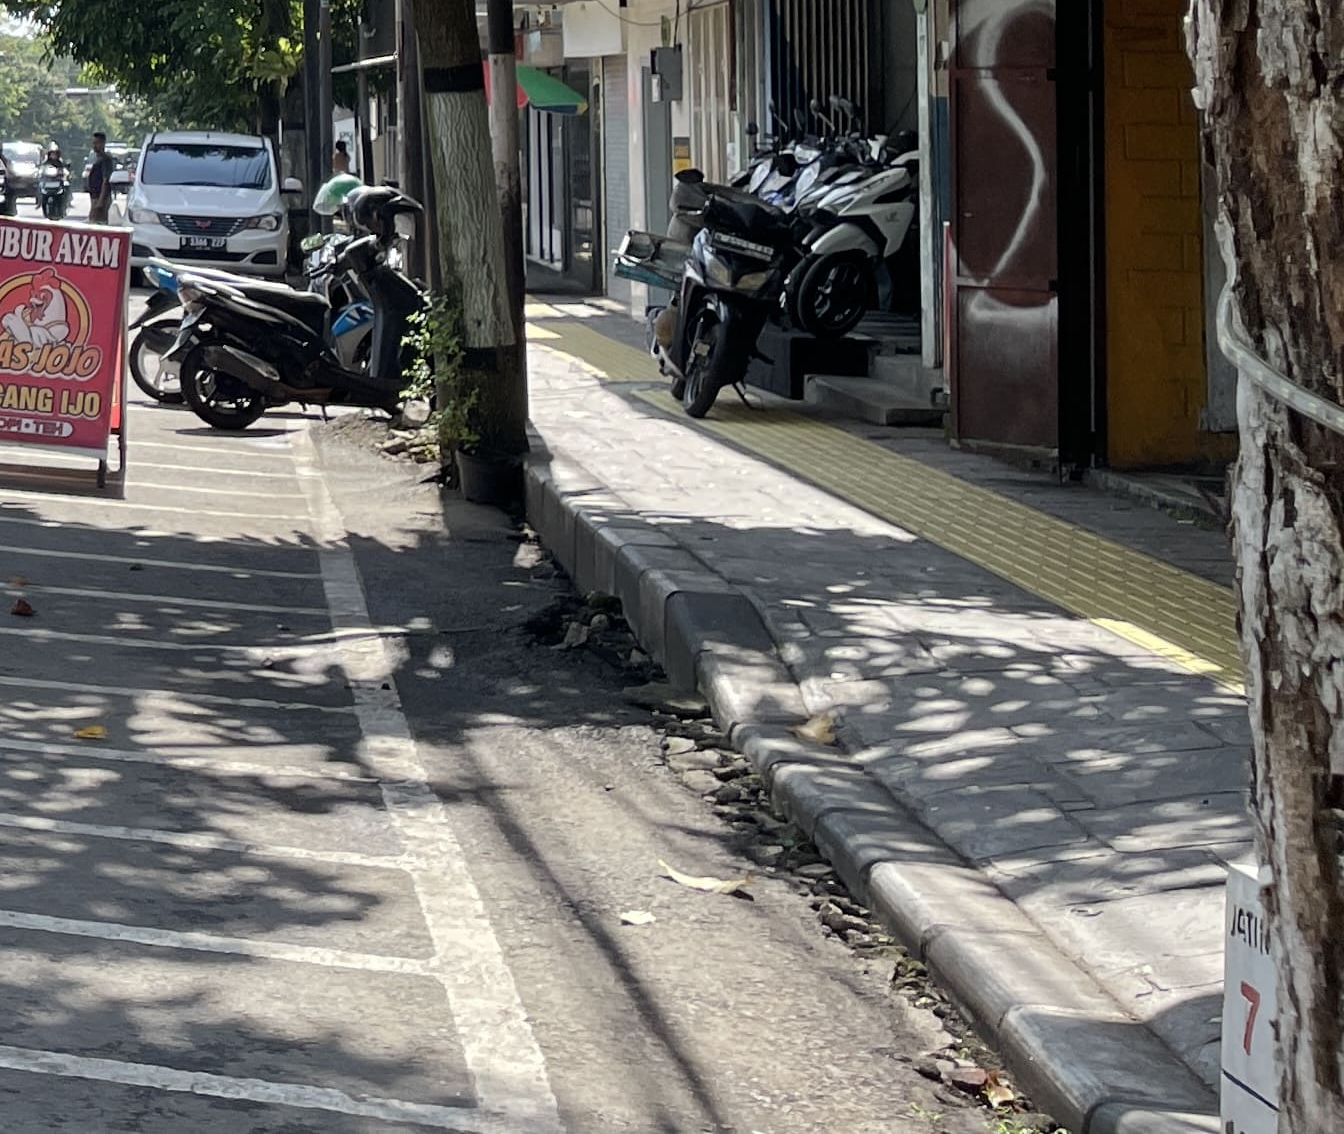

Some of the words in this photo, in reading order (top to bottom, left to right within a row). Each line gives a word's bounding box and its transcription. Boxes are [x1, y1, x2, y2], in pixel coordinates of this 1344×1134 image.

[55, 232, 121, 268] AYAM
[33, 344, 102, 378] JOJO
[60, 389, 101, 418] IJO
[33, 420, 64, 435] TEH
[1240, 980, 1261, 1056] 7
